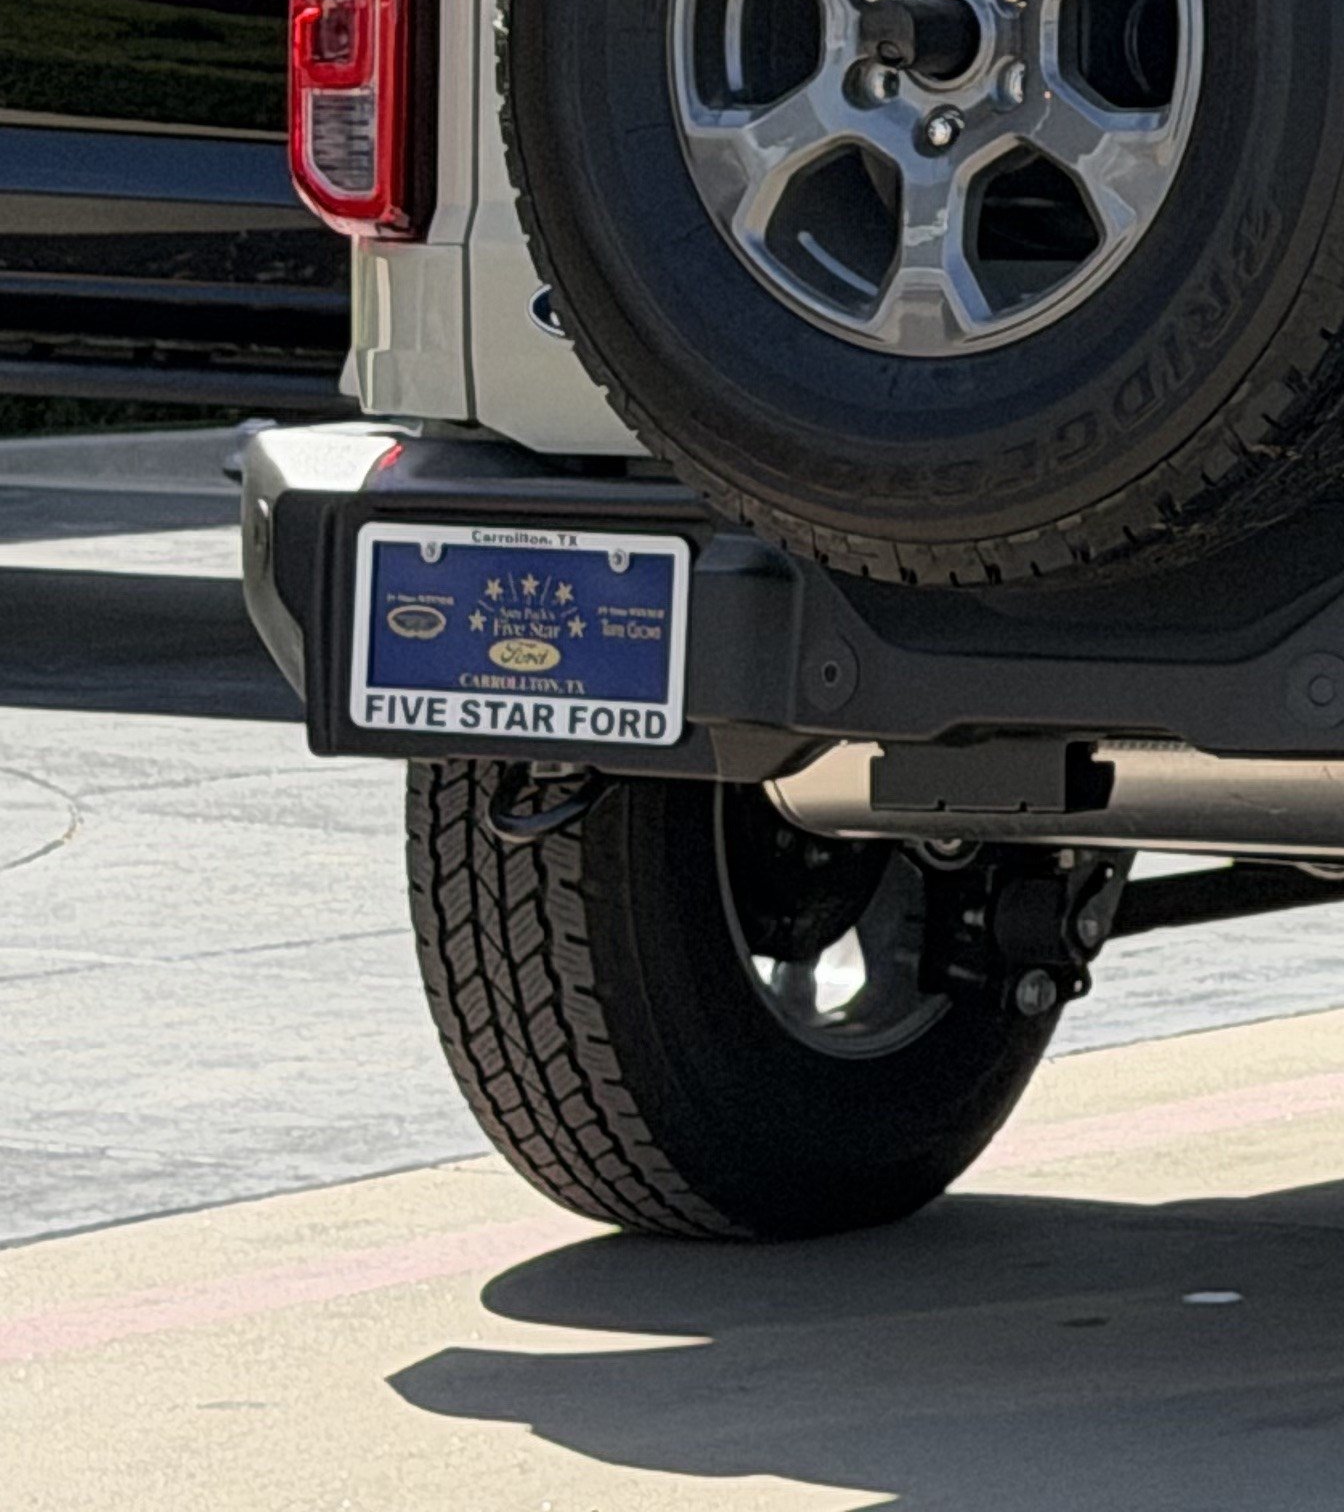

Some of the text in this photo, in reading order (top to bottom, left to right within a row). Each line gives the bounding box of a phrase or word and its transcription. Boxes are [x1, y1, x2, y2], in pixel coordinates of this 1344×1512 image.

[500, 641, 550, 665] Ford
[365, 694, 667, 740] FIVE STAR FORD
